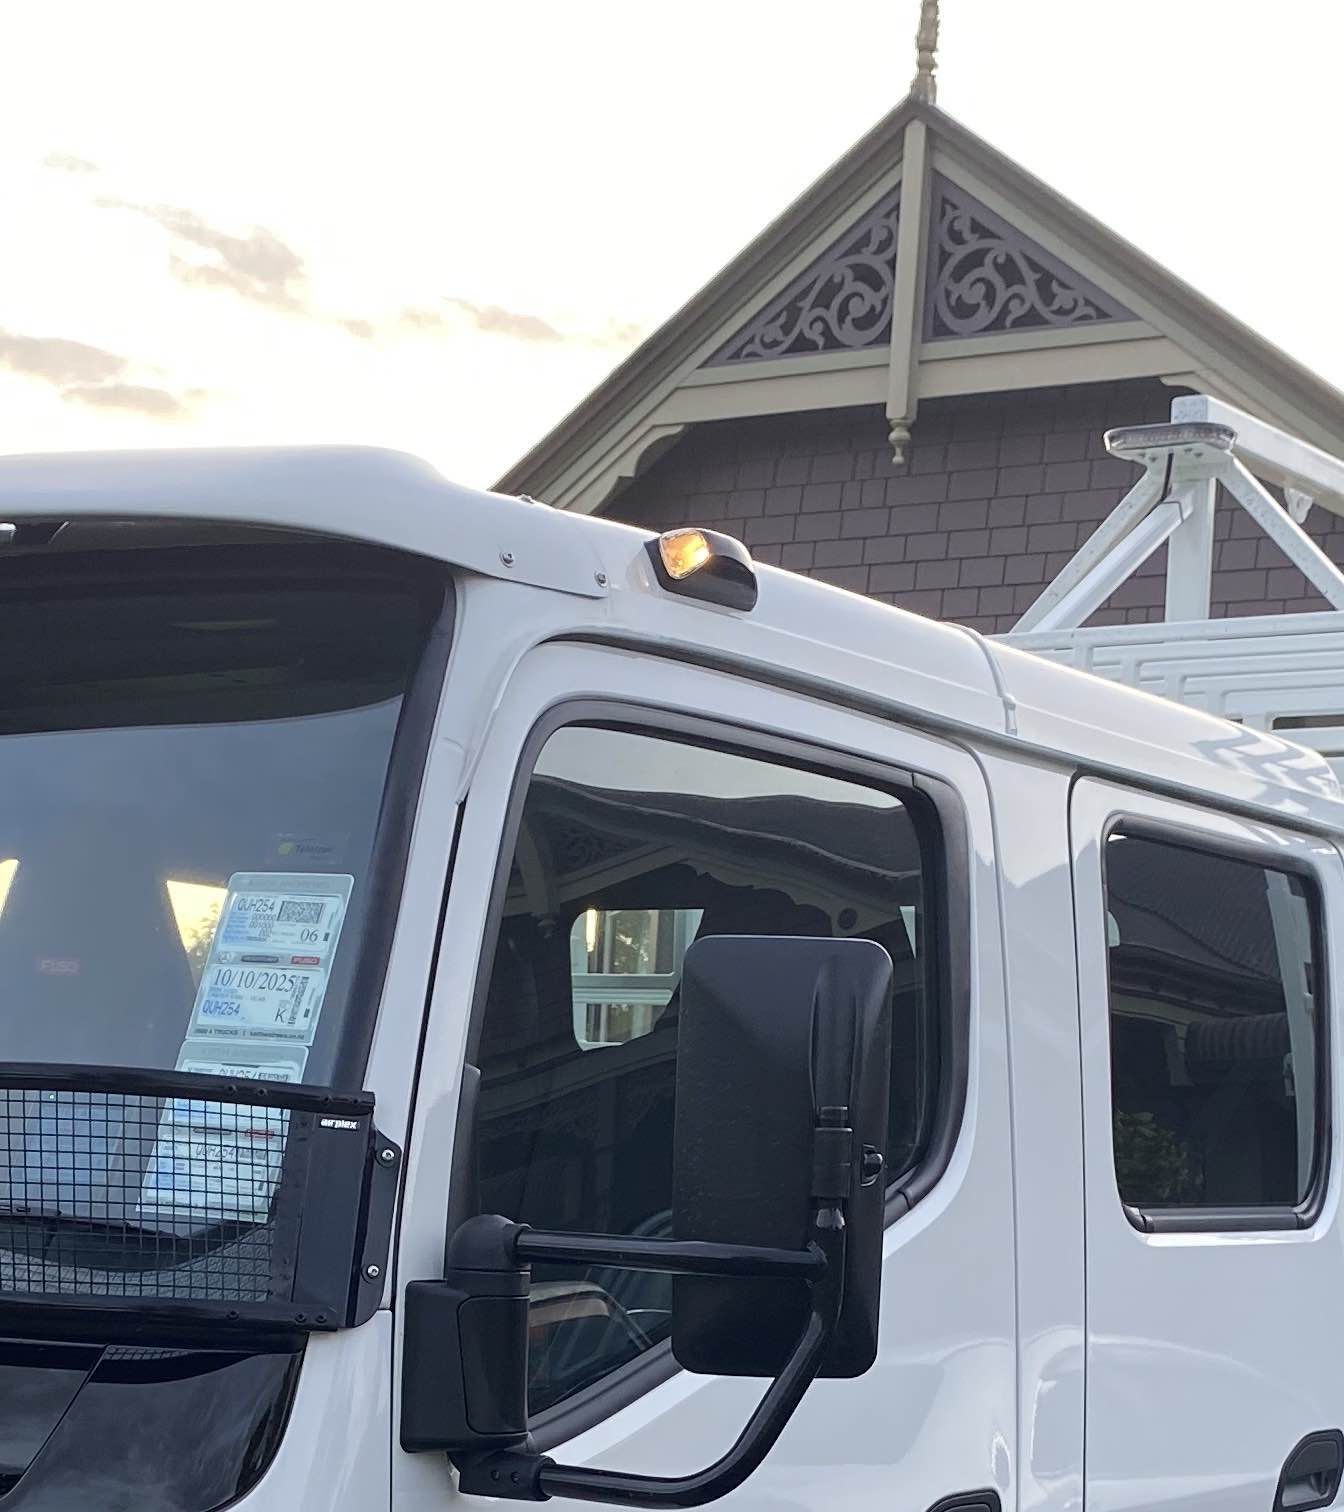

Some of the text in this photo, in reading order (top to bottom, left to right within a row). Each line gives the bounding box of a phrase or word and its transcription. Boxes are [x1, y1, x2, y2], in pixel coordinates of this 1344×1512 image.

[237, 897, 276, 913] QUH254
[300, 927, 319, 942] 06
[213, 968, 296, 993] 10/10/2025
[202, 999, 241, 1016] QUH254
[274, 1008, 287, 1024] K
[320, 1118, 358, 1130] airplex
